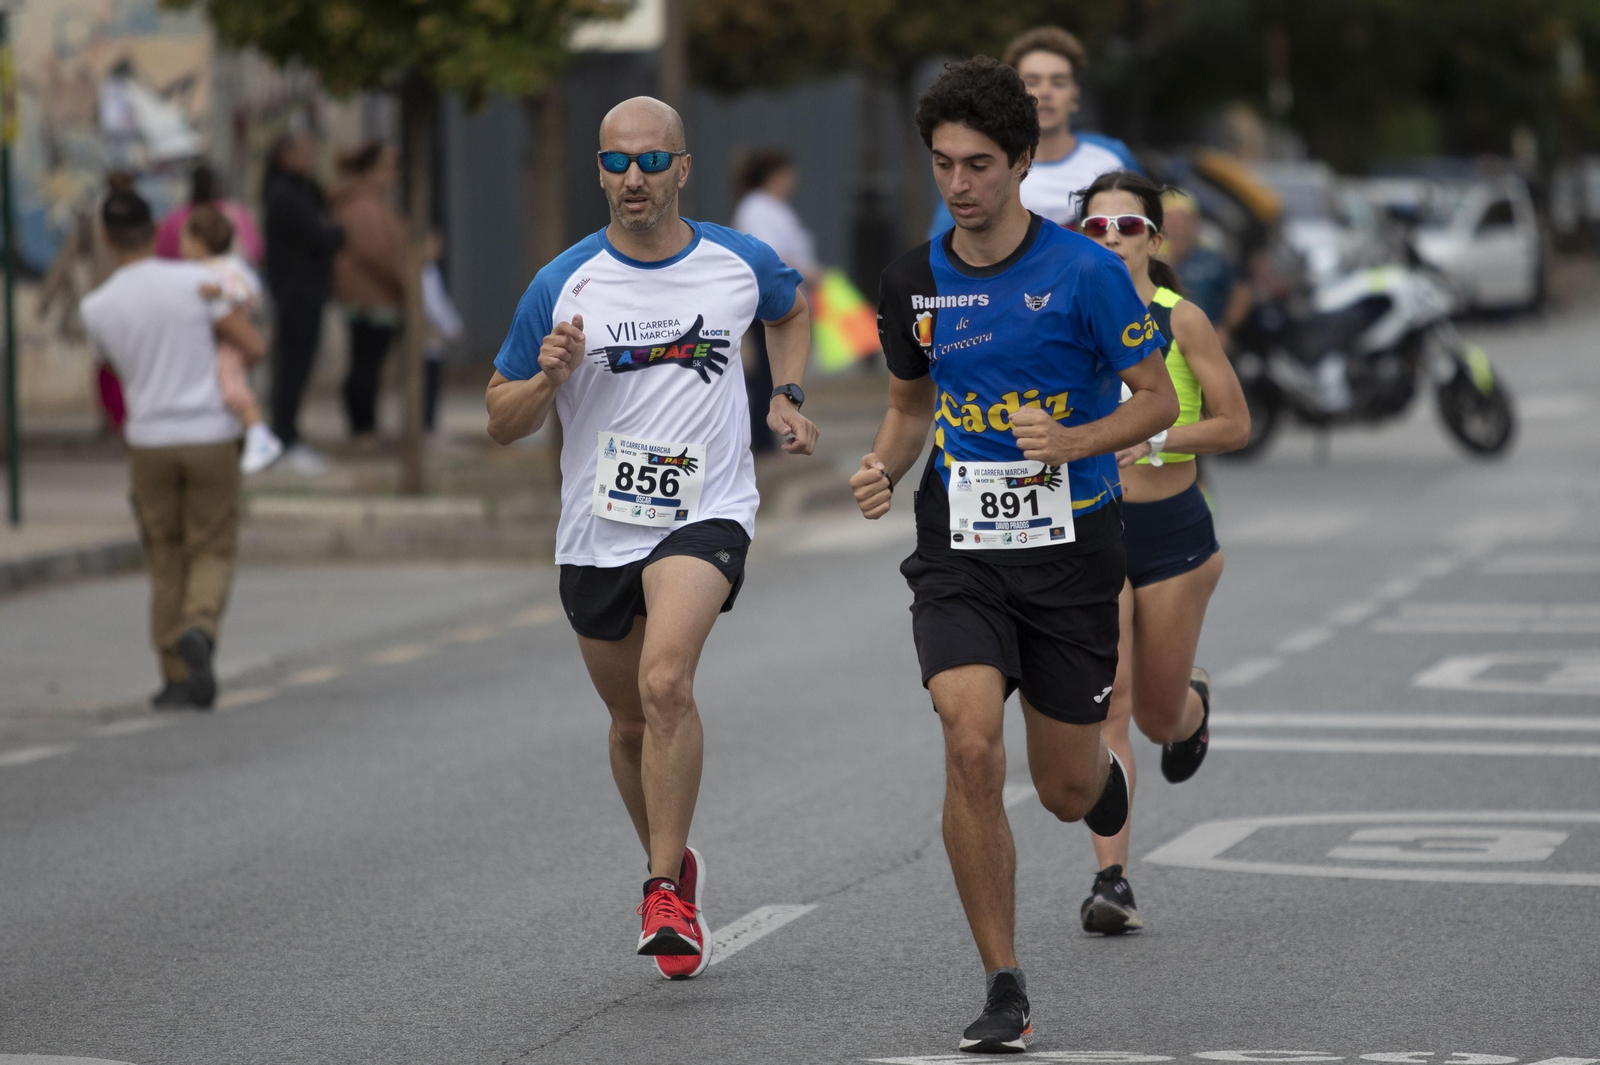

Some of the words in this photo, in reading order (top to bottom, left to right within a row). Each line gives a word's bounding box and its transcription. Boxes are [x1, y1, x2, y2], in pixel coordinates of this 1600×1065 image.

[911, 293, 990, 309] Runners
[638, 319, 681, 331] CARRERA
[956, 316, 970, 332] de
[606, 321, 637, 343] VII
[639, 329, 682, 341] MARCHA
[710, 329, 723, 337] OCT
[932, 331, 993, 361] Cervecera
[616, 344, 711, 366] ASPACE
[626, 440, 648, 451] CARRERA
[649, 445, 670, 454] MARCHA
[650, 456, 690, 465] ASPACE
[1005, 468, 1029, 476] MARCHA
[615, 462, 681, 498] 856
[1009, 475, 1052, 487] ASPACE
[980, 489, 1039, 519] 891
[995, 521, 1009, 530] DAVID
[1010, 521, 1030, 530] PRADOS
